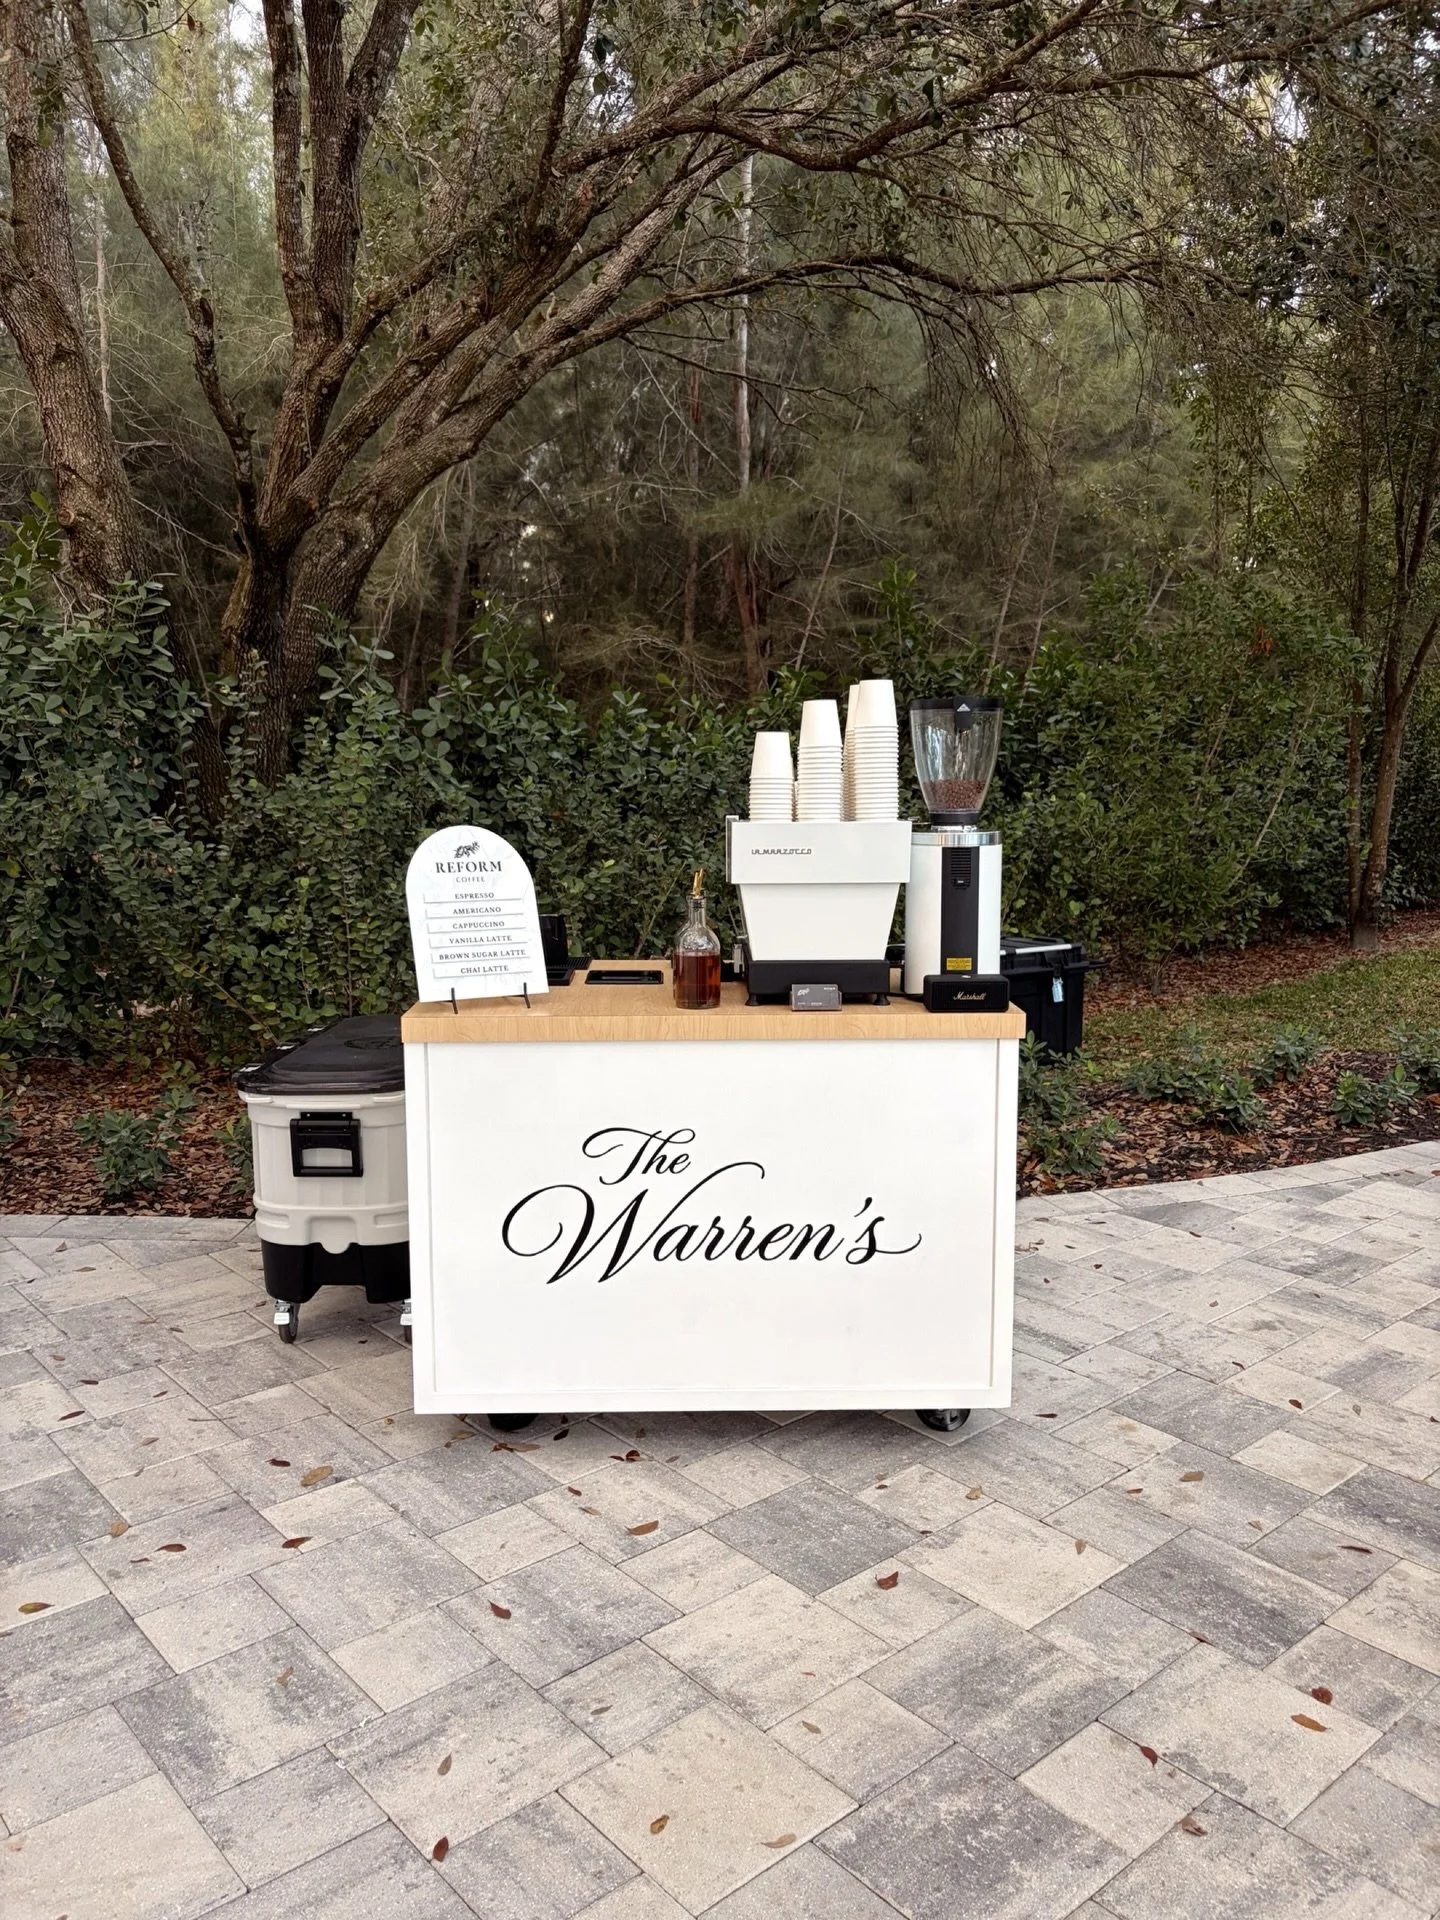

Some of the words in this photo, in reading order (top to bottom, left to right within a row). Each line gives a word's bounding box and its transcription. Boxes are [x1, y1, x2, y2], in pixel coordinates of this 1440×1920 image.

[435, 860, 503, 874] REFORM
[454, 892, 495, 900] ESPRESSO
[452, 906, 502, 915] AMERICANO
[452, 921, 505, 930] CAPPUCCINO
[449, 936, 484, 945] VANILLA
[486, 935, 513, 943] LATTE
[438, 952, 470, 961] BROWN
[471, 950, 498, 959] SUGAR
[500, 949, 526, 957] LATTE
[460, 966, 481, 974] CHAI
[483, 964, 510, 973] LATTE
[952, 991, 987, 1001] Marshall
[581, 1127, 696, 1185] The
[501, 1161, 922, 1285] Warren's
